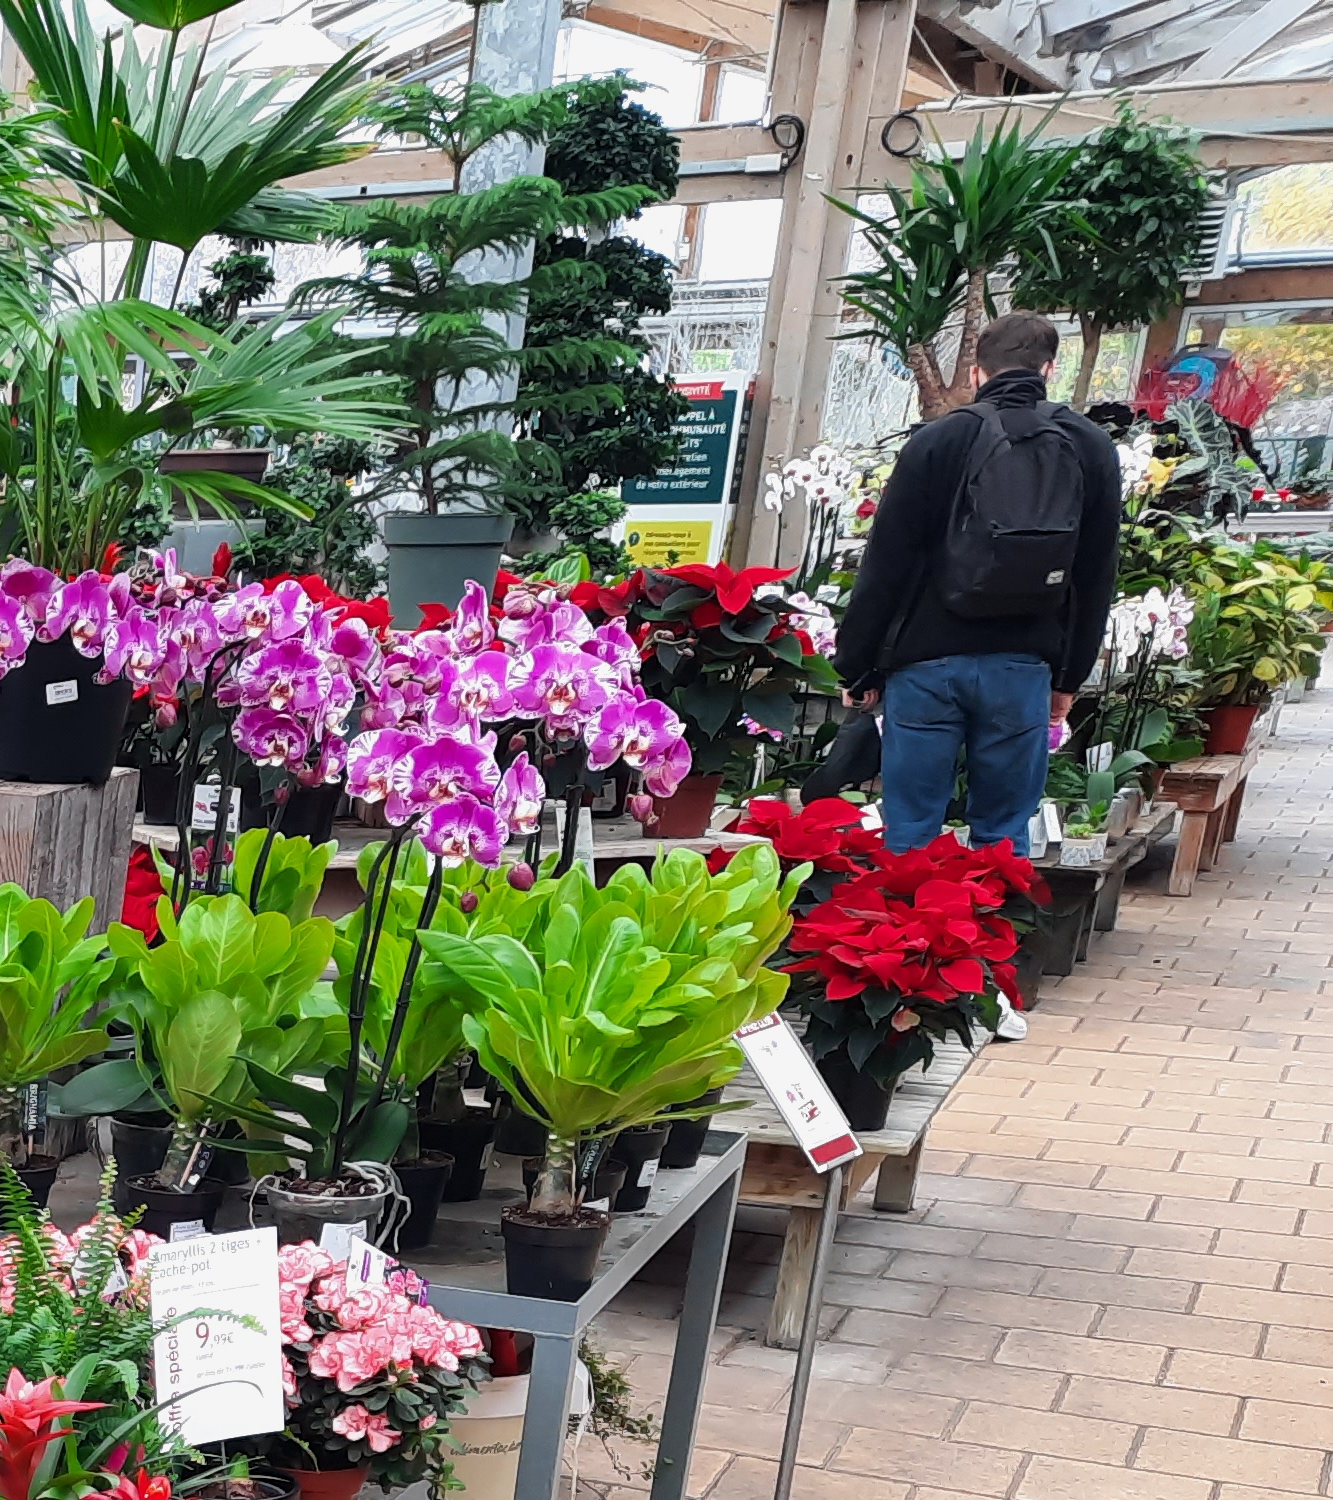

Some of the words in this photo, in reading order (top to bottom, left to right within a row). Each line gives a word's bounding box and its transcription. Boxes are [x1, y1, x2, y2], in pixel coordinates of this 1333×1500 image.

[210, 1241, 217, 1254] 2
[221, 1238, 250, 1253] tiges
[165, 1306, 183, 1385] spéciae
